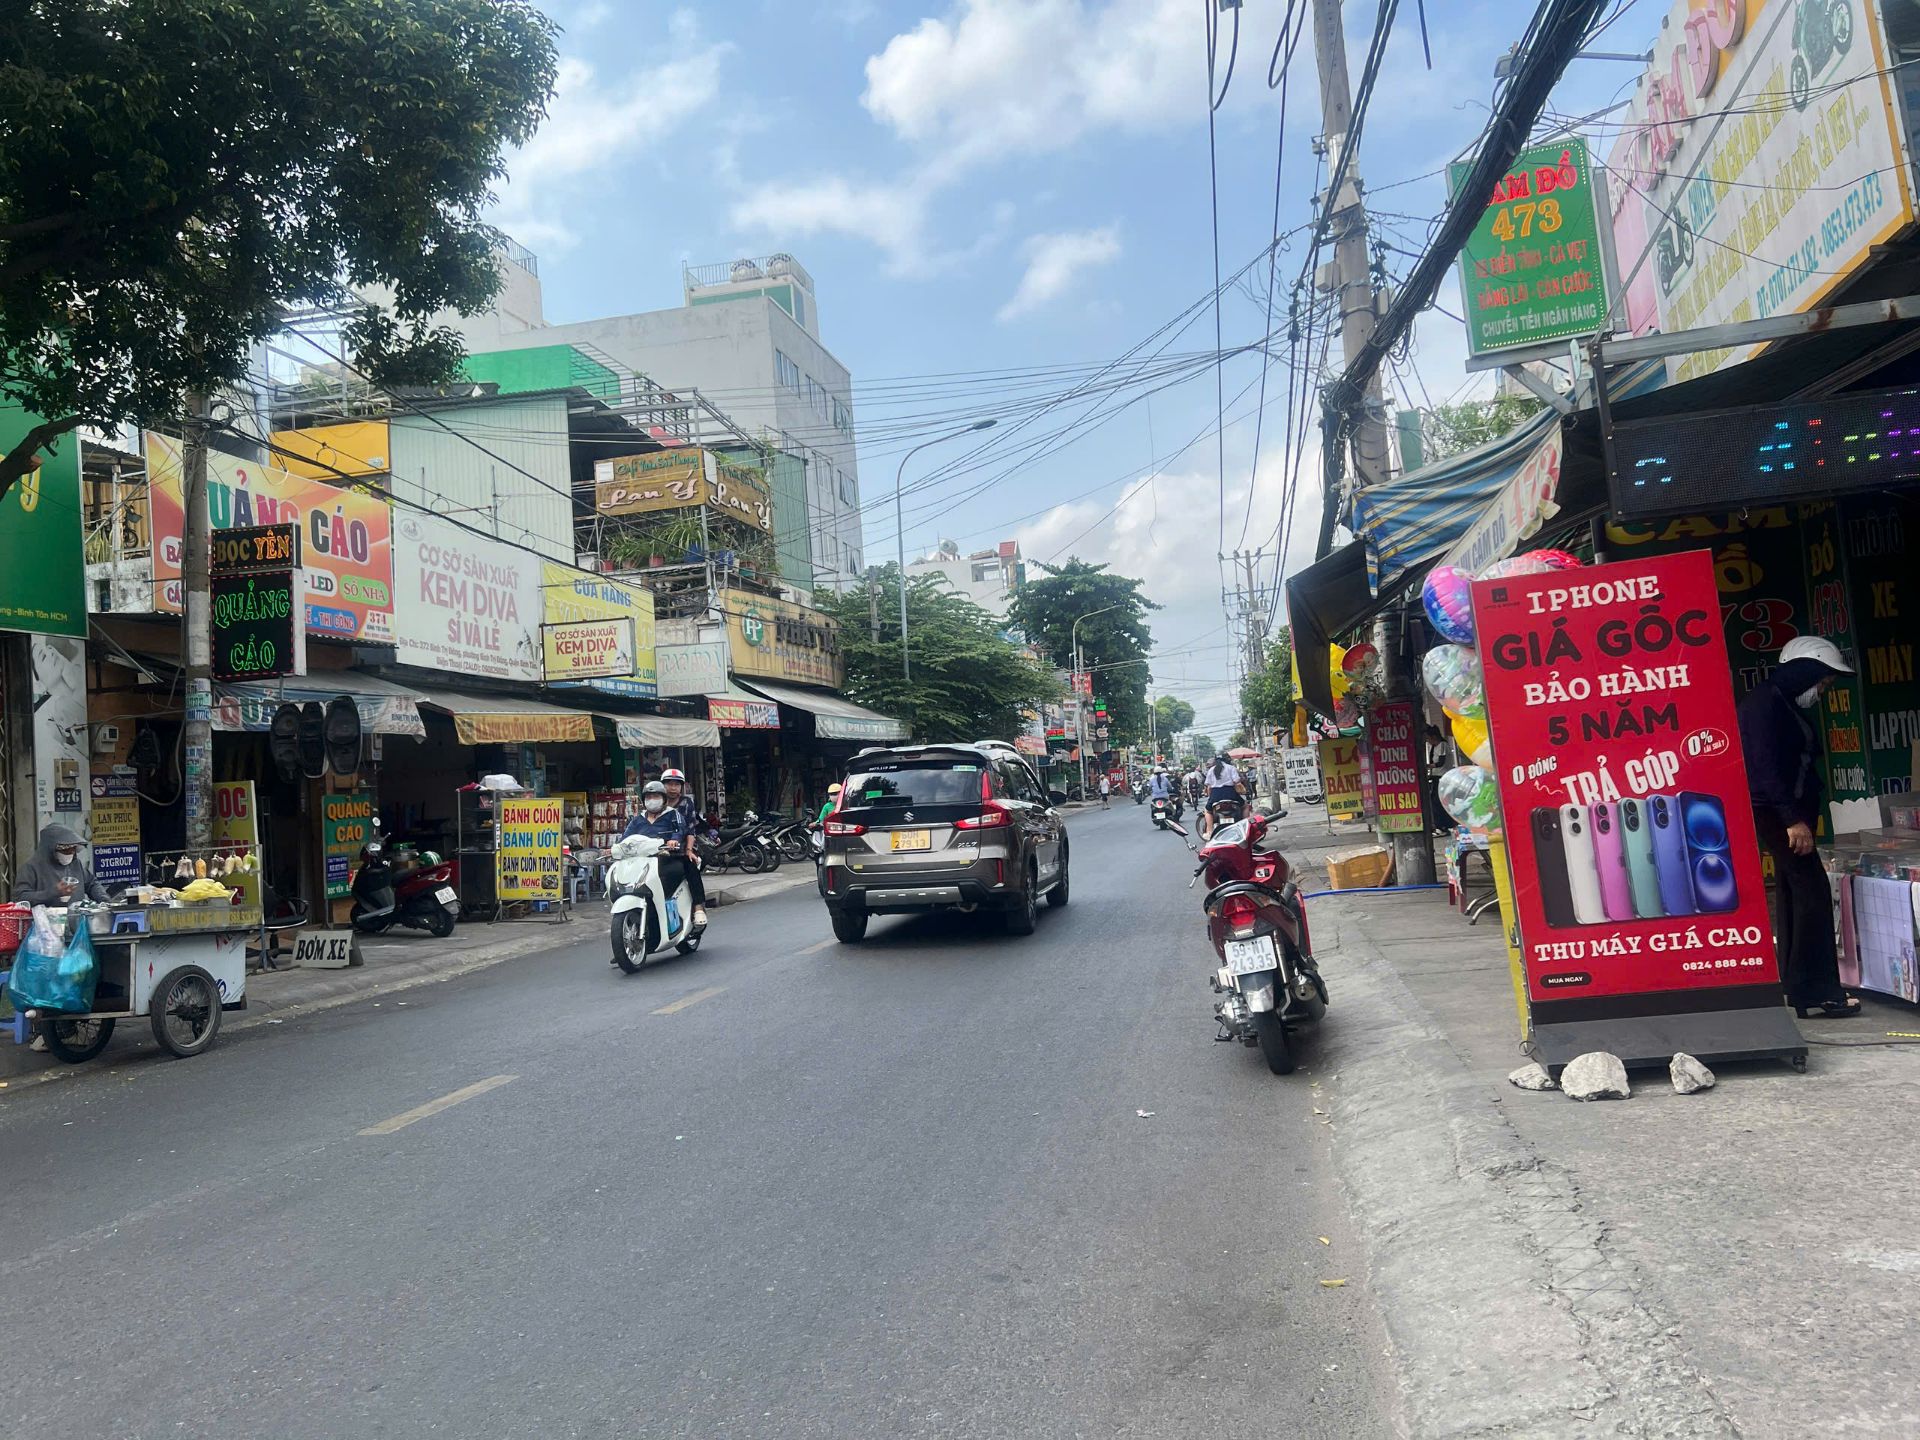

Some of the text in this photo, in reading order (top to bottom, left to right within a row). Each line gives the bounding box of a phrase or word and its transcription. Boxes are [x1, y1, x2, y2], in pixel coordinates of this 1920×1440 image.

[1491, 199, 1563, 241] 473
[1570, 302, 1597, 322] HÀNG
[310, 505, 369, 563] CÁO
[215, 538, 250, 567] BỌC
[254, 529, 290, 560] YÊN
[418, 542, 442, 567] CƠ
[311, 574, 334, 592] LED
[214, 579, 291, 629] QUẢNG
[420, 567, 468, 613] KEM
[473, 583, 520, 625] DIVA
[1812, 579, 1848, 637] 473
[1870, 579, 1900, 619] XE
[464, 617, 482, 649] VÀ
[555, 631, 568, 640] CƠ
[1492, 592, 1712, 671] GIÁ GỐC
[556, 637, 617, 655] KEM DIVA
[582, 653, 593, 666] VÀ
[1866, 636, 1915, 686] MÁY
[1523, 664, 1691, 706] BẢO HÀNH
[1549, 698, 1680, 746] 5 NĂM
[1687, 729, 1713, 756] 0%
[1512, 765, 1525, 786] 0
[1560, 748, 1681, 805] TRẢ GÓP
[57, 791, 80, 803] 376
[1378, 791, 1419, 811] NUI SAO
[503, 802, 560, 824] BÁNH CUỐN
[336, 821, 364, 842] CÁO
[503, 828, 533, 848] BÁNH
[100, 856, 133, 868] 3TGROUP
[503, 853, 520, 872] BÁNH
[520, 851, 537, 872] CUỐN
[295, 935, 348, 961] BƠM XE
[1534, 926, 1763, 963] THU MÁY GIÁ CAO
[1230, 952, 1274, 974] 243.35
[1682, 960, 1712, 971] 0824
[1714, 958, 1737, 969] 888
[1740, 956, 1763, 967] 488
[1547, 975, 1584, 985] MUA NGAY
